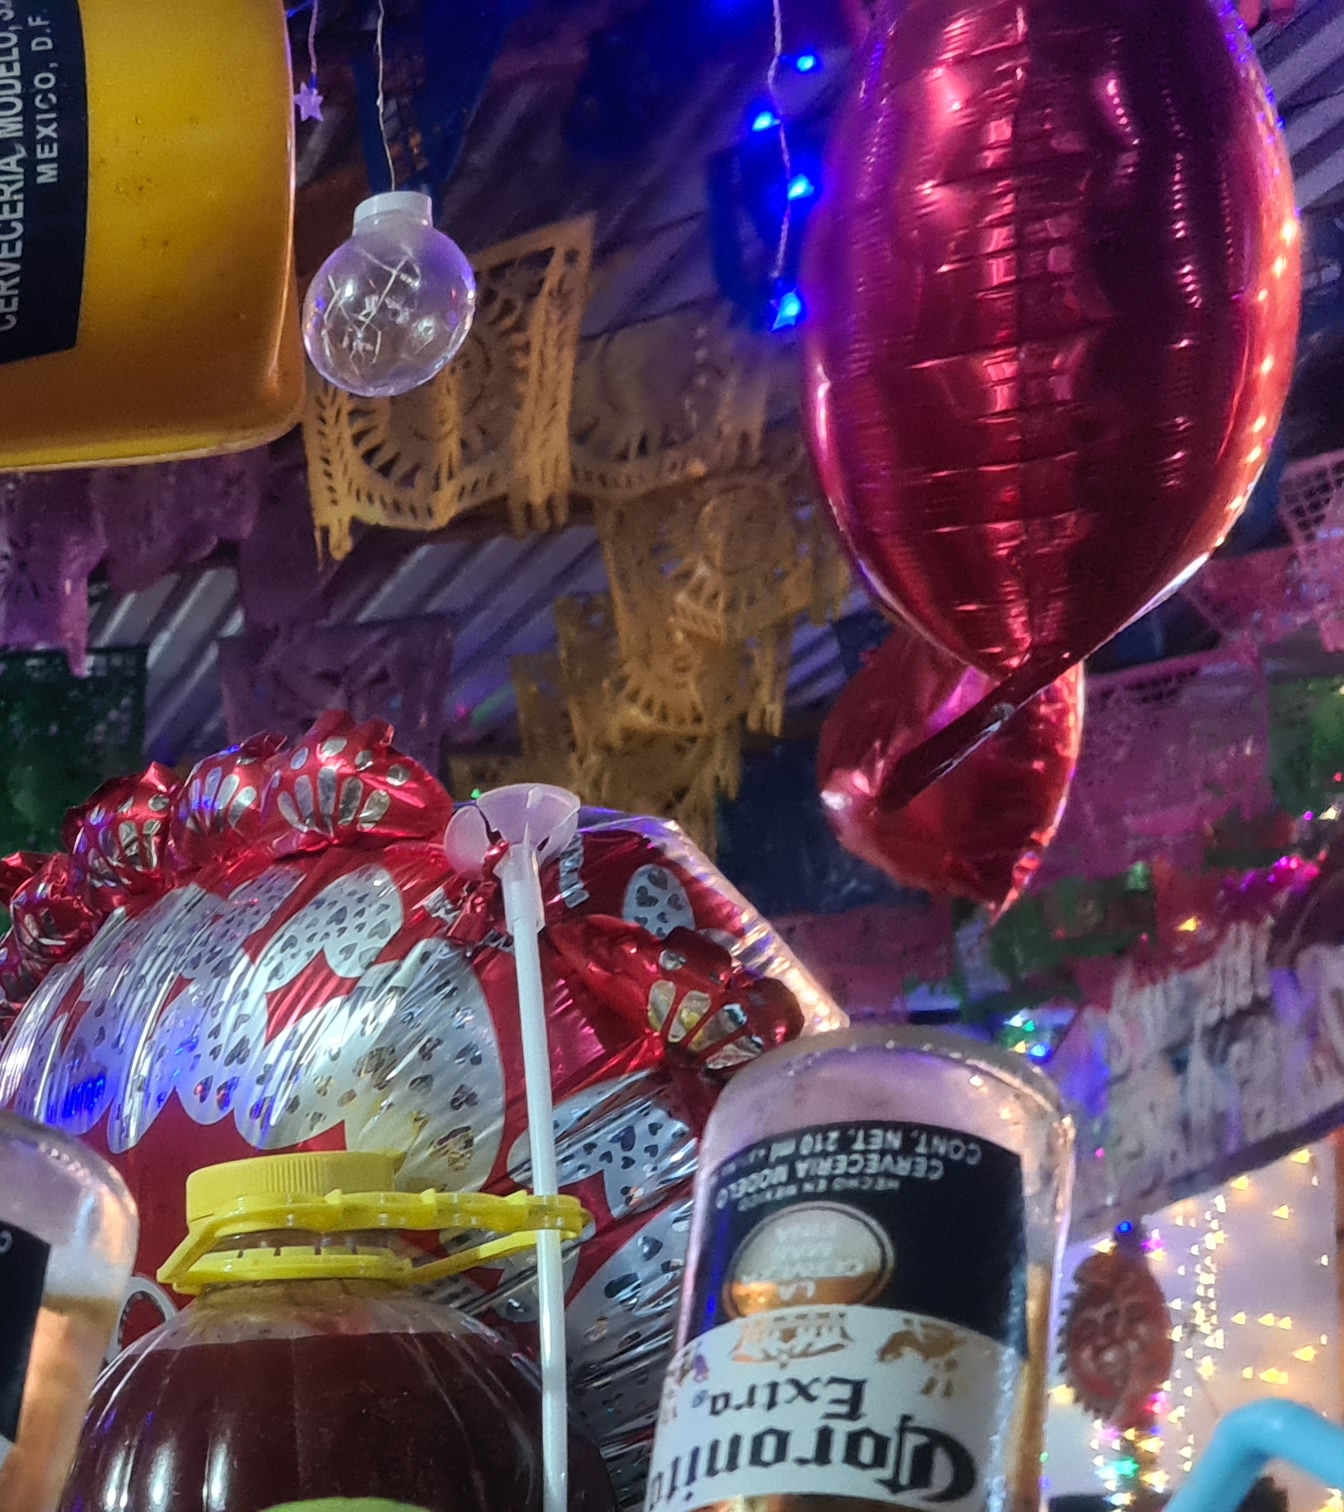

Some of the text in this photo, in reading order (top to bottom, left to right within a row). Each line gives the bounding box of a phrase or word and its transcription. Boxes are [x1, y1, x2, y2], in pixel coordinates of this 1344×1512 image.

[850, 1129, 904, 1151] NET.
[911, 1130, 983, 1166] CONT.
[794, 1152, 945, 1182] CERVECERIA
[708, 1376, 869, 1421] Extra
